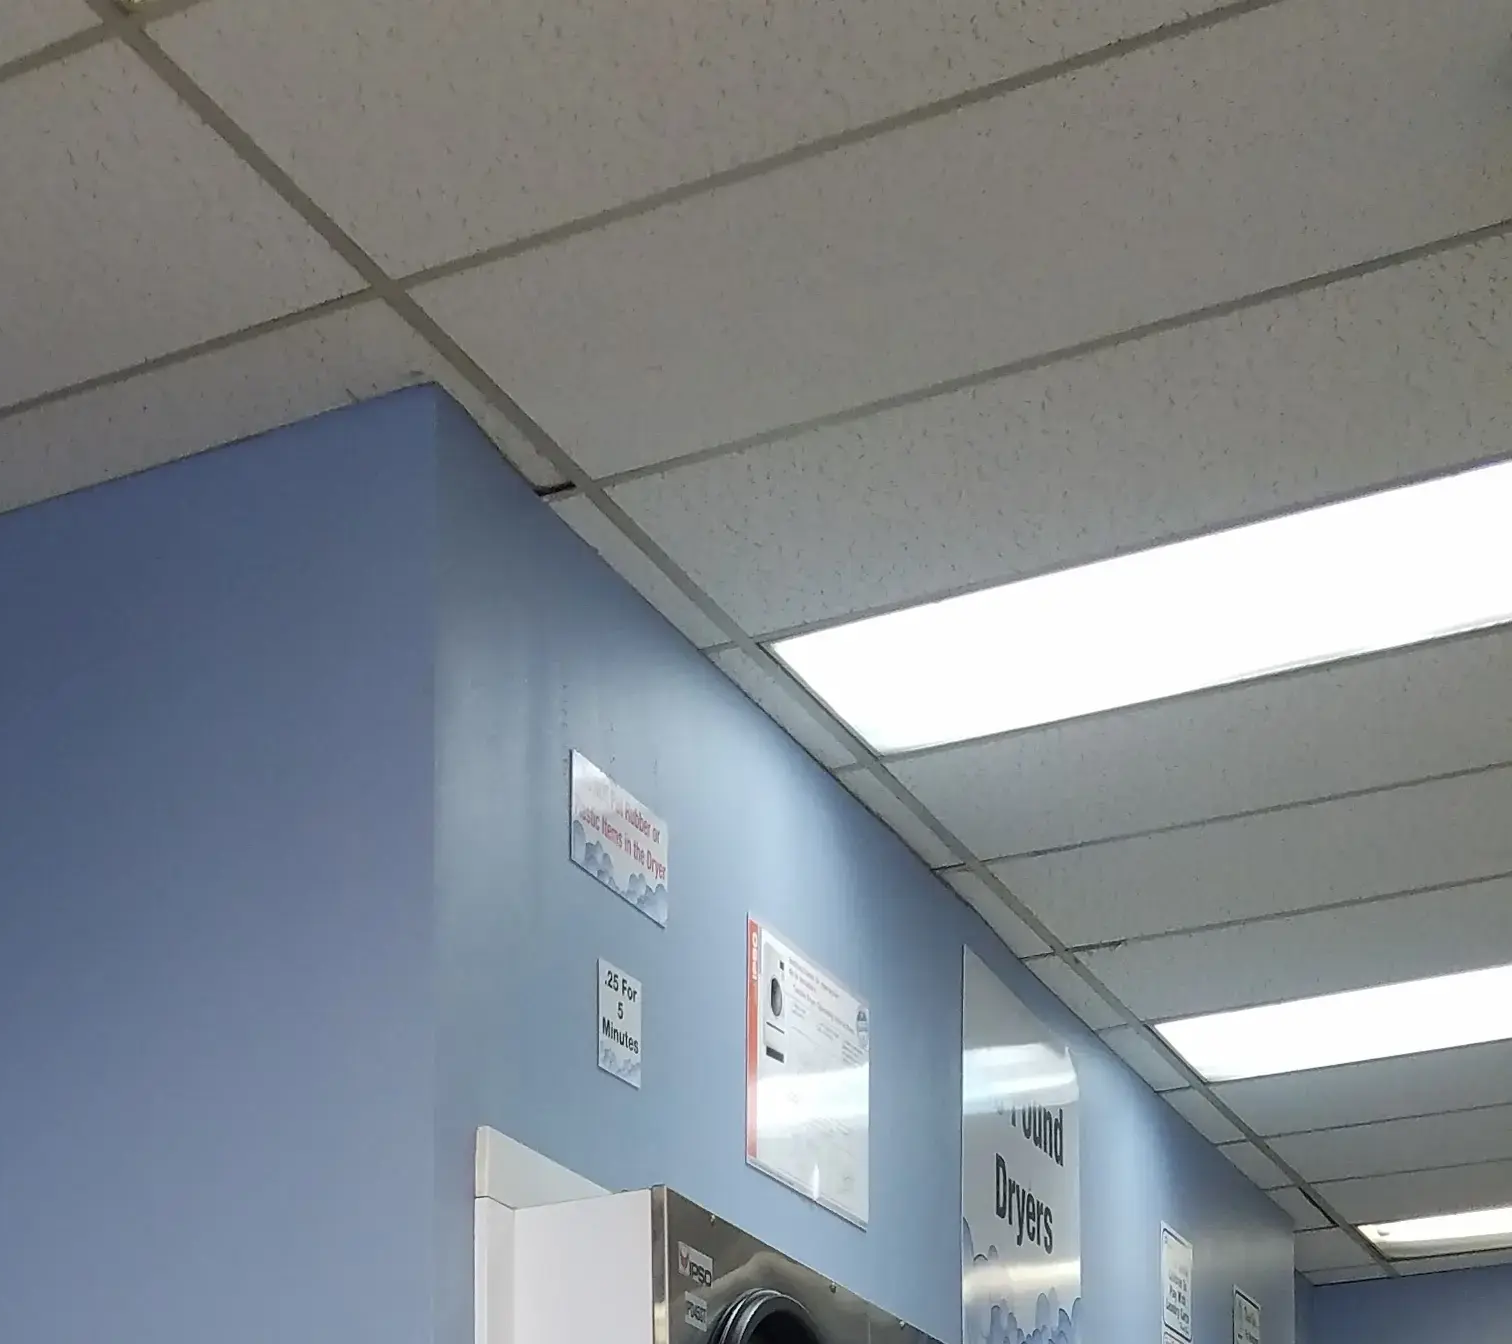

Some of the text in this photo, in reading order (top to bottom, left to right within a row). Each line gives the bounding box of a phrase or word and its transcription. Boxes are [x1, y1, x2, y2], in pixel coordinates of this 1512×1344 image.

[625, 799, 651, 838] Rubber
[653, 827, 660, 843] or
[602, 814, 623, 848] Items
[624, 833, 632, 856] in
[633, 842, 644, 865] the
[647, 848, 666, 880] Dryer
[604, 970, 637, 1002] .25 For
[617, 1002, 624, 1019] 5
[602, 1016, 639, 1054] Minutes
[995, 1153, 1053, 1254] Dryers
[690, 1261, 712, 1287] IPSO
